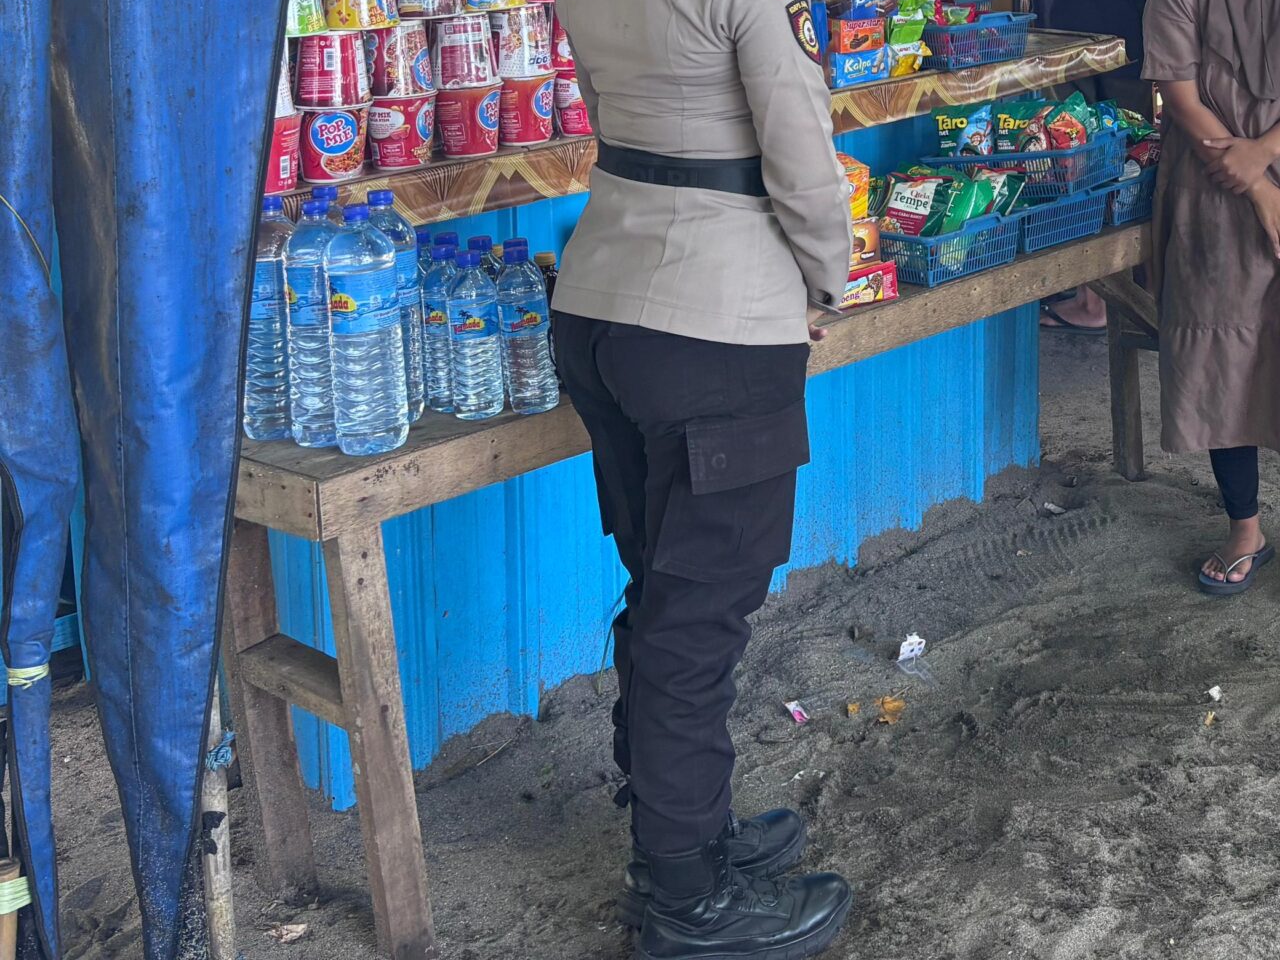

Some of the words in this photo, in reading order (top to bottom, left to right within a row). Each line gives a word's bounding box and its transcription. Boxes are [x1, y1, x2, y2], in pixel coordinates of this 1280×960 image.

[844, 56, 871, 74] Kalpa
[318, 118, 346, 138] POP
[936, 115, 968, 131] Taro
[997, 113, 1029, 130] Taro
[323, 128, 354, 149] MIE
[938, 129, 950, 137] net
[998, 128, 1009, 136] net
[894, 191, 929, 211] Tempe
